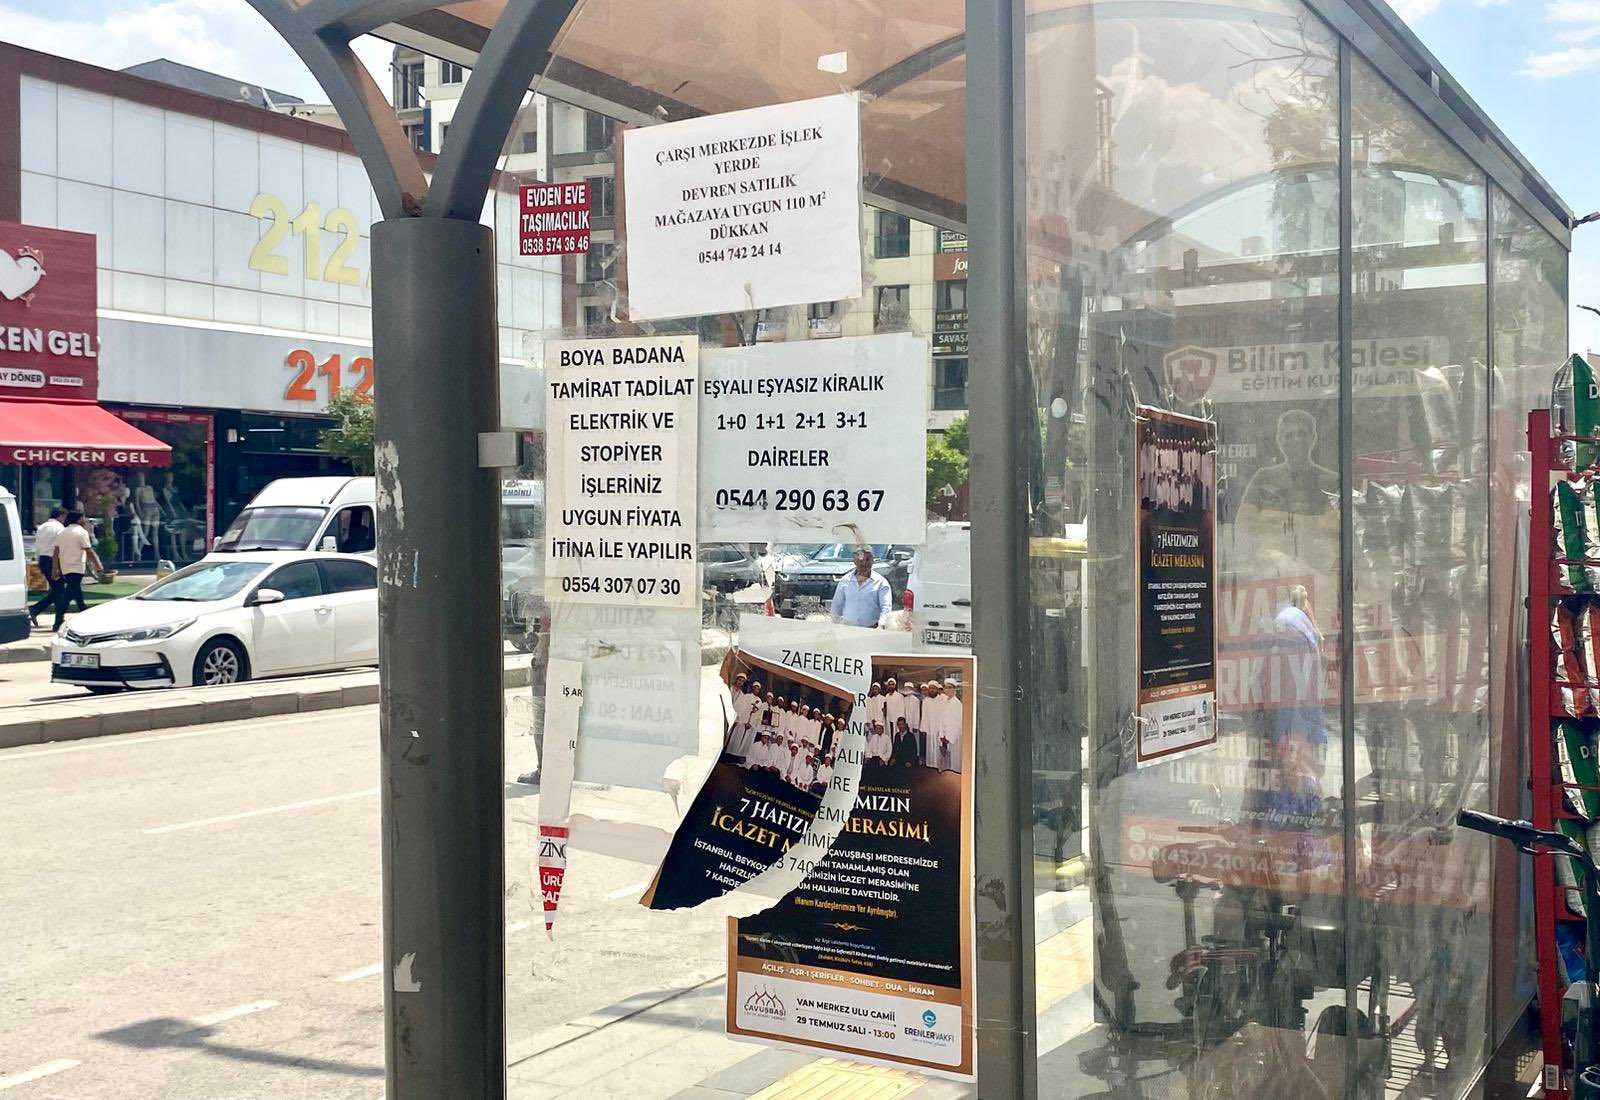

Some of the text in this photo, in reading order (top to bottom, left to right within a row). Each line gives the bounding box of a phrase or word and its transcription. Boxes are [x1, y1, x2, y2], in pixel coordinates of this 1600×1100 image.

[656, 126, 823, 166] ÇARŞI MERKEZDE İŞLEK
[714, 157, 760, 175] YERDE
[527, 185, 586, 207] EVDEN EVE
[682, 174, 797, 201] DEVREN SATILIK
[522, 210, 590, 236] TAŞIMACILIK
[655, 206, 731, 227] MAĞAZAYA
[733, 200, 782, 216] UYGUN
[785, 198, 805, 210] 110
[248, 192, 361, 288] 212
[710, 221, 769, 240] DÜKKAN
[522, 235, 589, 254] 0538 574 36 46
[698, 242, 782, 264] 0544 742 24 14
[48, 330, 96, 357] GEL
[560, 346, 685, 367] BOYA BADANA
[1228, 344, 1309, 373] Bilim
[11, 371, 42, 383] DÖNER
[551, 376, 694, 399] TAMİRAT TADİLAT
[704, 373, 884, 398] EŞYALI EŞYASIZ KİRALIK
[570, 409, 674, 430] ELEKTRİK VE
[717, 411, 868, 430] 1+0 1+1 2+1 3+1
[113, 451, 150, 464] GEL
[581, 441, 662, 462] STOPİYER
[748, 446, 829, 467] DAİRELER
[581, 474, 662, 497] İŞLERİNİZ
[716, 489, 885, 512] 0544 290 63 67
[562, 506, 682, 526] UYGUN FİYATA
[552, 537, 692, 560] İTİNA İLE YAPILIR
[562, 576, 681, 595] 0554 307 07 30
[782, 649, 864, 676] ZAFERLER
[740, 797, 751, 812] 7
[710, 806, 780, 848] İCAZET
[694, 837, 768, 872] İSTANBUL BEYKOZ
[828, 849, 939, 869] ÇAVUŞBAŞI MEDRESEMİZDE
[705, 869, 711, 878] 7
[832, 861, 886, 876] TAMAMLAMIŞ
[887, 868, 910, 877] OLAN
[838, 874, 866, 885] İCAZET
[812, 884, 850, 896] HALKIMIZ
[851, 888, 900, 902] DAVETLİDİR.
[762, 963, 784, 974] AÇILIŞ
[909, 984, 935, 996] İKRAM
[797, 998, 896, 1022] VAN MERKEZ ULU CAMİİ
[796, 1016, 807, 1024] 29
[809, 1018, 846, 1031] TEMMUZ
[847, 1025, 866, 1036] SALI
[873, 1029, 896, 1040] 13:00
